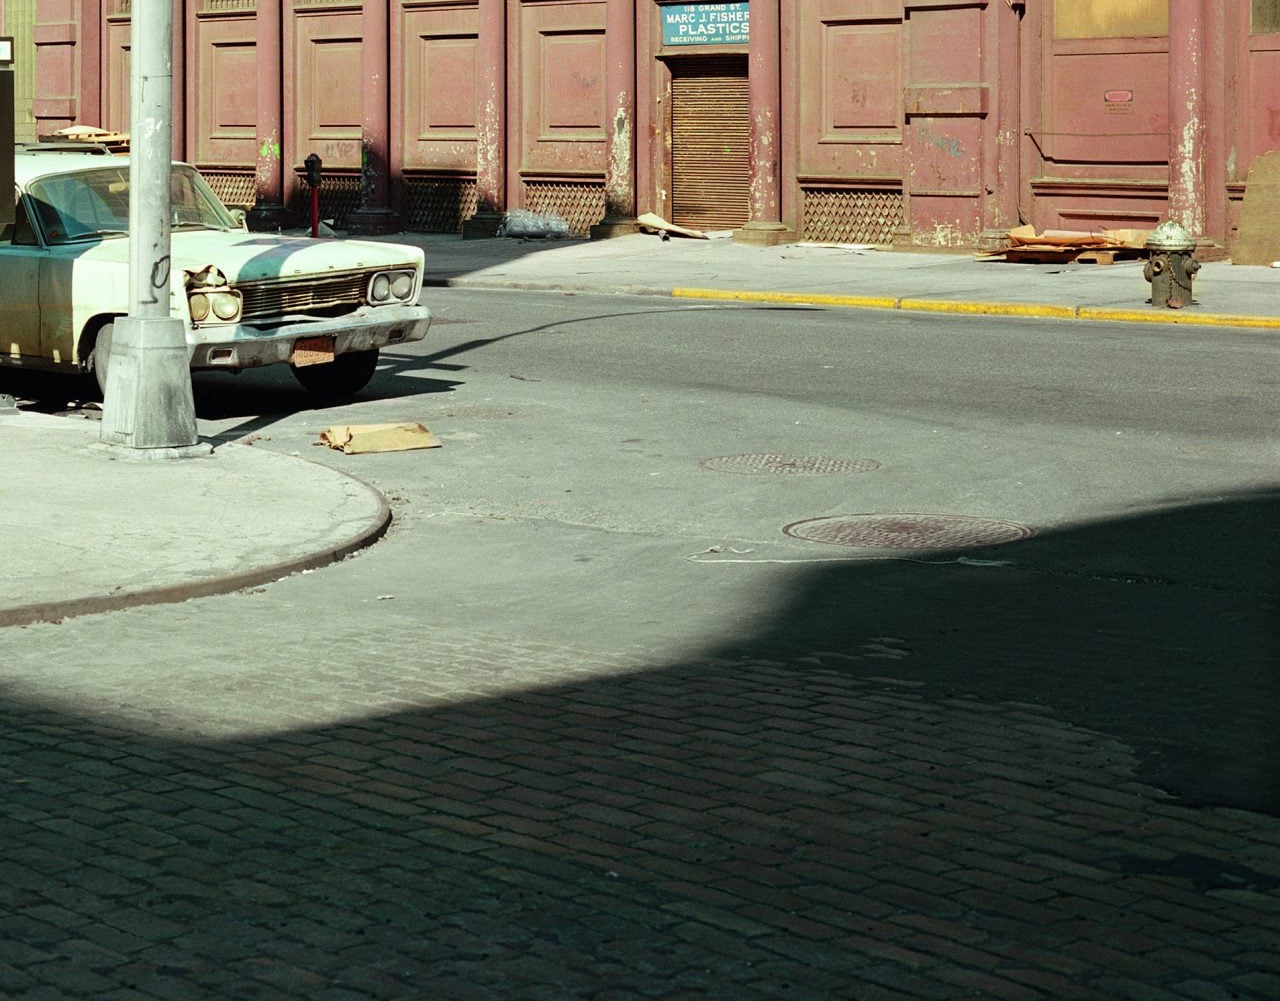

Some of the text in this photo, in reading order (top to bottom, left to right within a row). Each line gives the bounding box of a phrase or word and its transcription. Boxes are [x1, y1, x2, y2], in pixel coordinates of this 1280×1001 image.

[698, 3, 726, 12] GRAND
[666, 13, 696, 24] MARC
[679, 22, 749, 36] PLASTICS
[670, 35, 708, 43] RECEIVING
